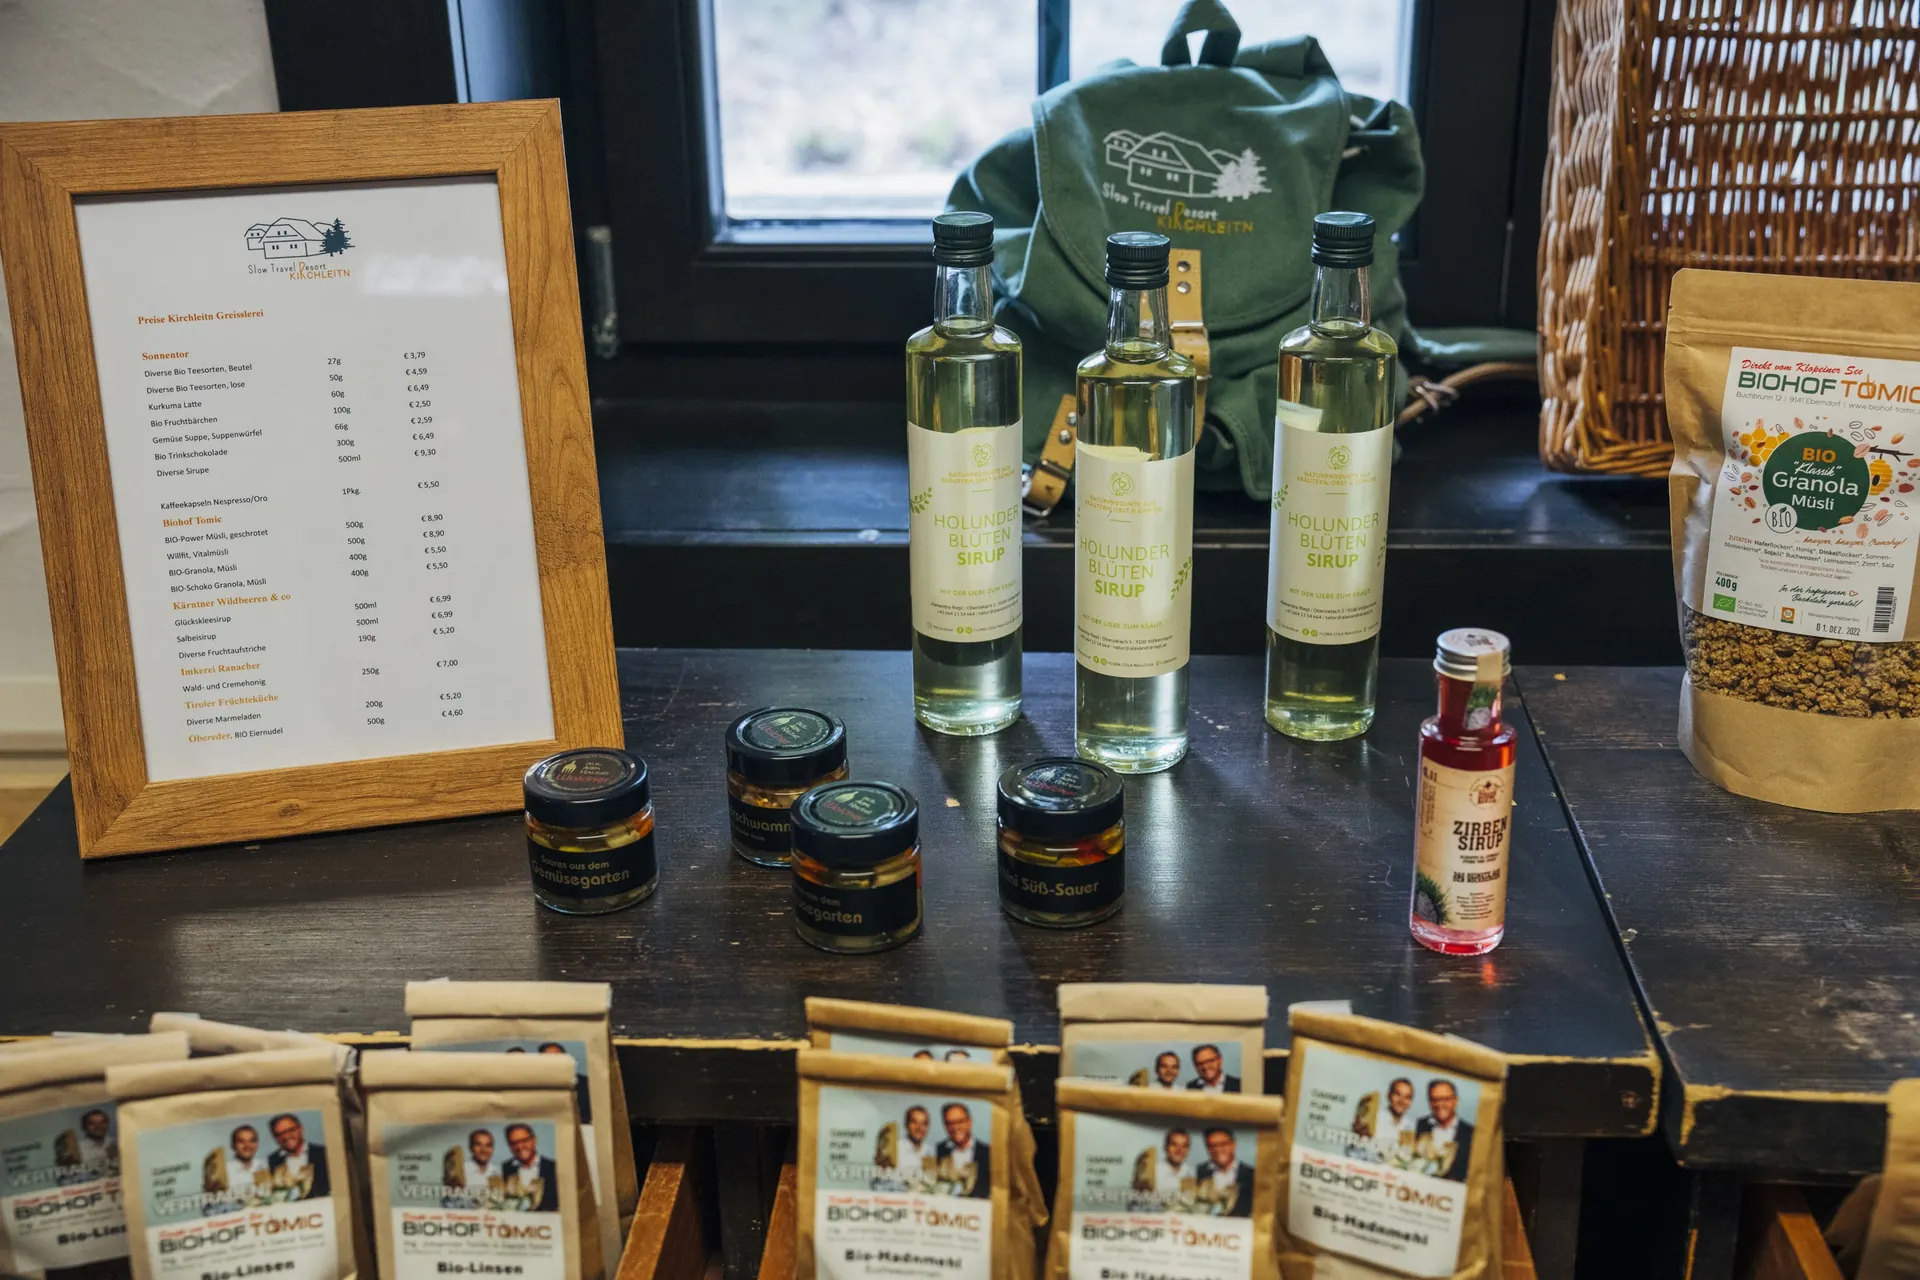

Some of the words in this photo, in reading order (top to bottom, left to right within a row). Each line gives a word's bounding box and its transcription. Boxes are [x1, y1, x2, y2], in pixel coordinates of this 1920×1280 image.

[248, 265, 267, 274] Slow
[271, 262, 296, 273] Travel
[290, 270, 350, 280] KIRCHLEITN
[138, 316, 165, 324] Preise
[168, 313, 213, 322] Kirchleitn
[216, 310, 264, 319] Greisslerei
[142, 352, 189, 360] Sonnentor
[188, 366, 226, 374] Teesorten,
[229, 364, 252, 372] Beutel
[1742, 360, 1772, 370] Direkt
[1796, 363, 1841, 374] Klopeiner
[1844, 366, 1863, 375] See
[329, 374, 343, 382] 50g
[1738, 371, 1837, 395] BIOHOF
[190, 383, 228, 391] Teesorten,
[416, 400, 431, 408] 2,50
[165, 417, 217, 426] Fruchtbärchen
[153, 436, 183, 444] Gemüse
[212, 429, 262, 440] Suppenwürfel
[337, 439, 354, 447] 300g
[169, 449, 227, 459] Trinkschokolade
[1803, 448, 1836, 463] BIO
[186, 467, 209, 475] Sirupe
[424, 481, 439, 489] 5,50
[1773, 472, 1858, 496] Granola
[161, 499, 211, 510] Kaffeekapseln
[214, 495, 267, 506] Nespresso/Oro
[1792, 494, 1834, 510] Müsli
[163, 518, 193, 527] Biohof
[195, 516, 222, 524] Tomic
[428, 514, 443, 522] 8,90
[934, 505, 1019, 530] HOLUNDER
[1288, 512, 1379, 532] HOLUNDER
[346, 521, 363, 529] 500g
[165, 535, 204, 543] BIO-Power
[230, 530, 268, 539] geschrotet
[429, 530, 444, 538] 8,90
[949, 527, 1011, 547] BLÜTEN
[1300, 533, 1367, 550] BLÜTEN
[167, 552, 191, 560] Willfit,
[193, 549, 228, 557] Vitalmüsli
[431, 546, 446, 554] 5,50
[1080, 536, 1169, 561] HOLUNDER
[957, 548, 1005, 566] SIRUP
[1307, 553, 1359, 568] SIRUP
[169, 567, 215, 576] BIO-Granola,
[217, 564, 237, 572] Müsli
[433, 562, 448, 570] 5,50
[1089, 558, 1153, 579] BLÜTEN
[171, 583, 212, 592] BIO-Schoko
[247, 578, 266, 586] Müsli
[1095, 580, 1145, 598] SIRUP
[173, 601, 214, 610] Kärntner
[217, 596, 267, 606] Wildbeeren
[436, 595, 451, 603] 6,99
[175, 616, 231, 626] Glückskleesirup
[357, 618, 378, 626] 500ml
[177, 634, 216, 642] Salbeisirup
[208, 645, 266, 656] Fruchtaufstriche
[181, 666, 215, 676] Imkerei
[218, 663, 260, 672] Ranacher
[222, 679, 266, 689] Cremehonig
[185, 700, 216, 709] Tiroler
[218, 694, 278, 706] Früchteküche
[446, 692, 461, 700] 5,20
[216, 713, 261, 722] Marmeladen
[448, 709, 463, 717] 4,60
[250, 727, 283, 736] Eiernudel
[1453, 816, 1508, 836] ZIRBEN
[1458, 834, 1503, 850] SIRUP
[1300, 1163, 1378, 1192] BIOHOF
[1384, 1183, 1453, 1213] TOMIC
[827, 1206, 908, 1222] BIOHOF
[914, 1209, 980, 1231] TOMIC
[159, 1225, 245, 1254] BIOHOF
[250, 1214, 323, 1236] TOMIC
[403, 1222, 481, 1237] BIOHOF
[484, 1224, 552, 1240] TOMIC
[438, 1262, 523, 1274] Bio-Linsen
